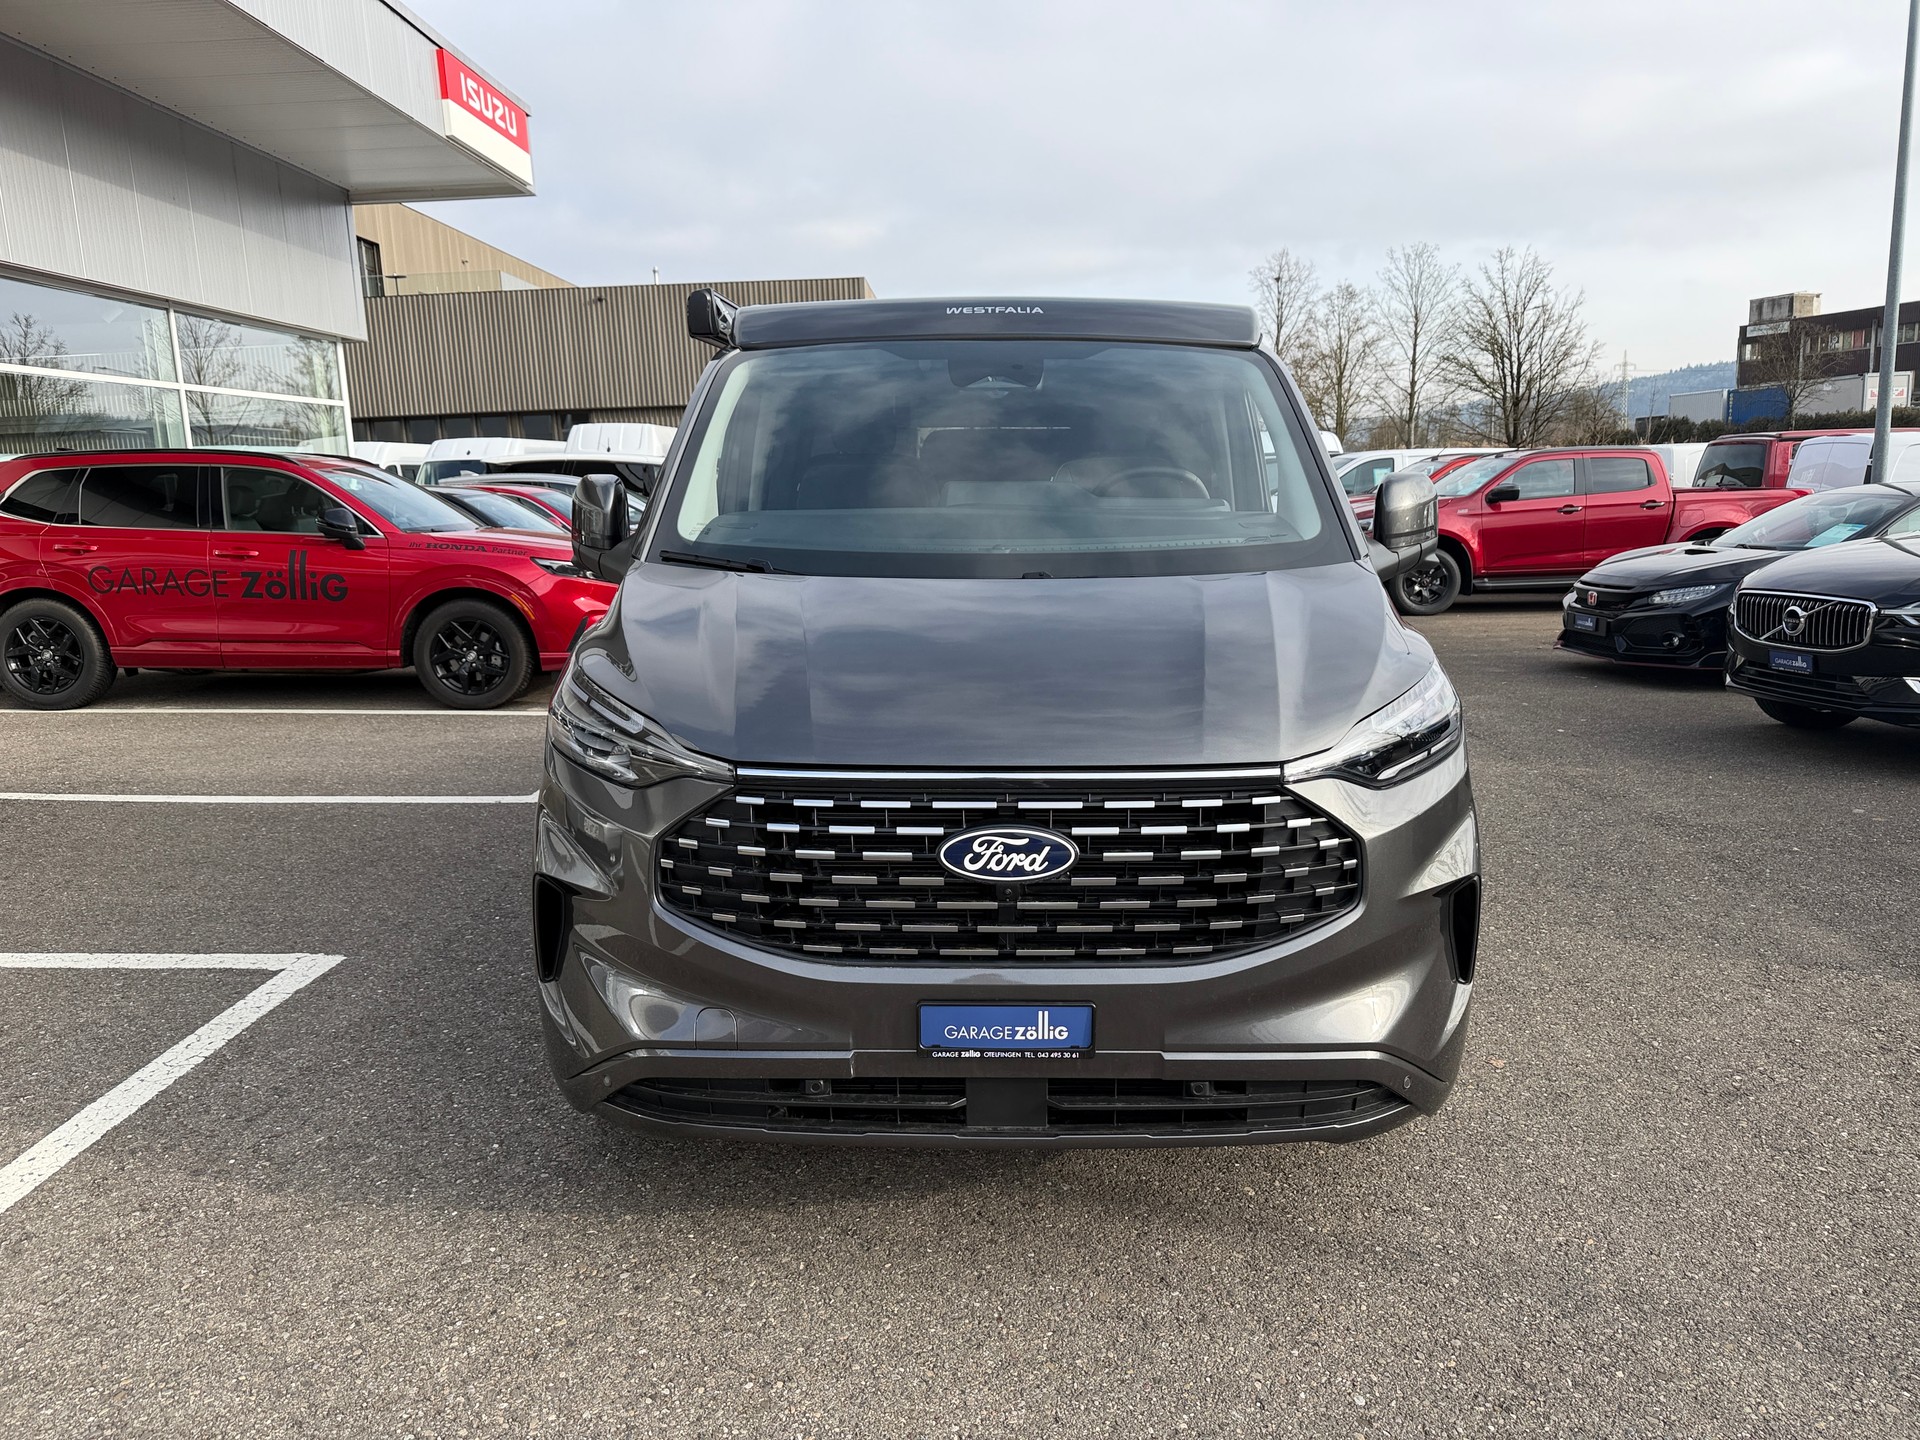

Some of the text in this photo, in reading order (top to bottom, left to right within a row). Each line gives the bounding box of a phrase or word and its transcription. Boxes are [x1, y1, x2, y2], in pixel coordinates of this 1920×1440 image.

[460, 71, 517, 137] ISUZU
[946, 306, 1044, 315] WESTFALIA
[425, 542, 487, 553] HONDA
[491, 546, 528, 556] Partner
[87, 566, 229, 597] GARAGE
[963, 835, 1051, 872] Ford
[944, 1025, 1013, 1040] GARAGE
[1050, 1051, 1061, 1059] 495
